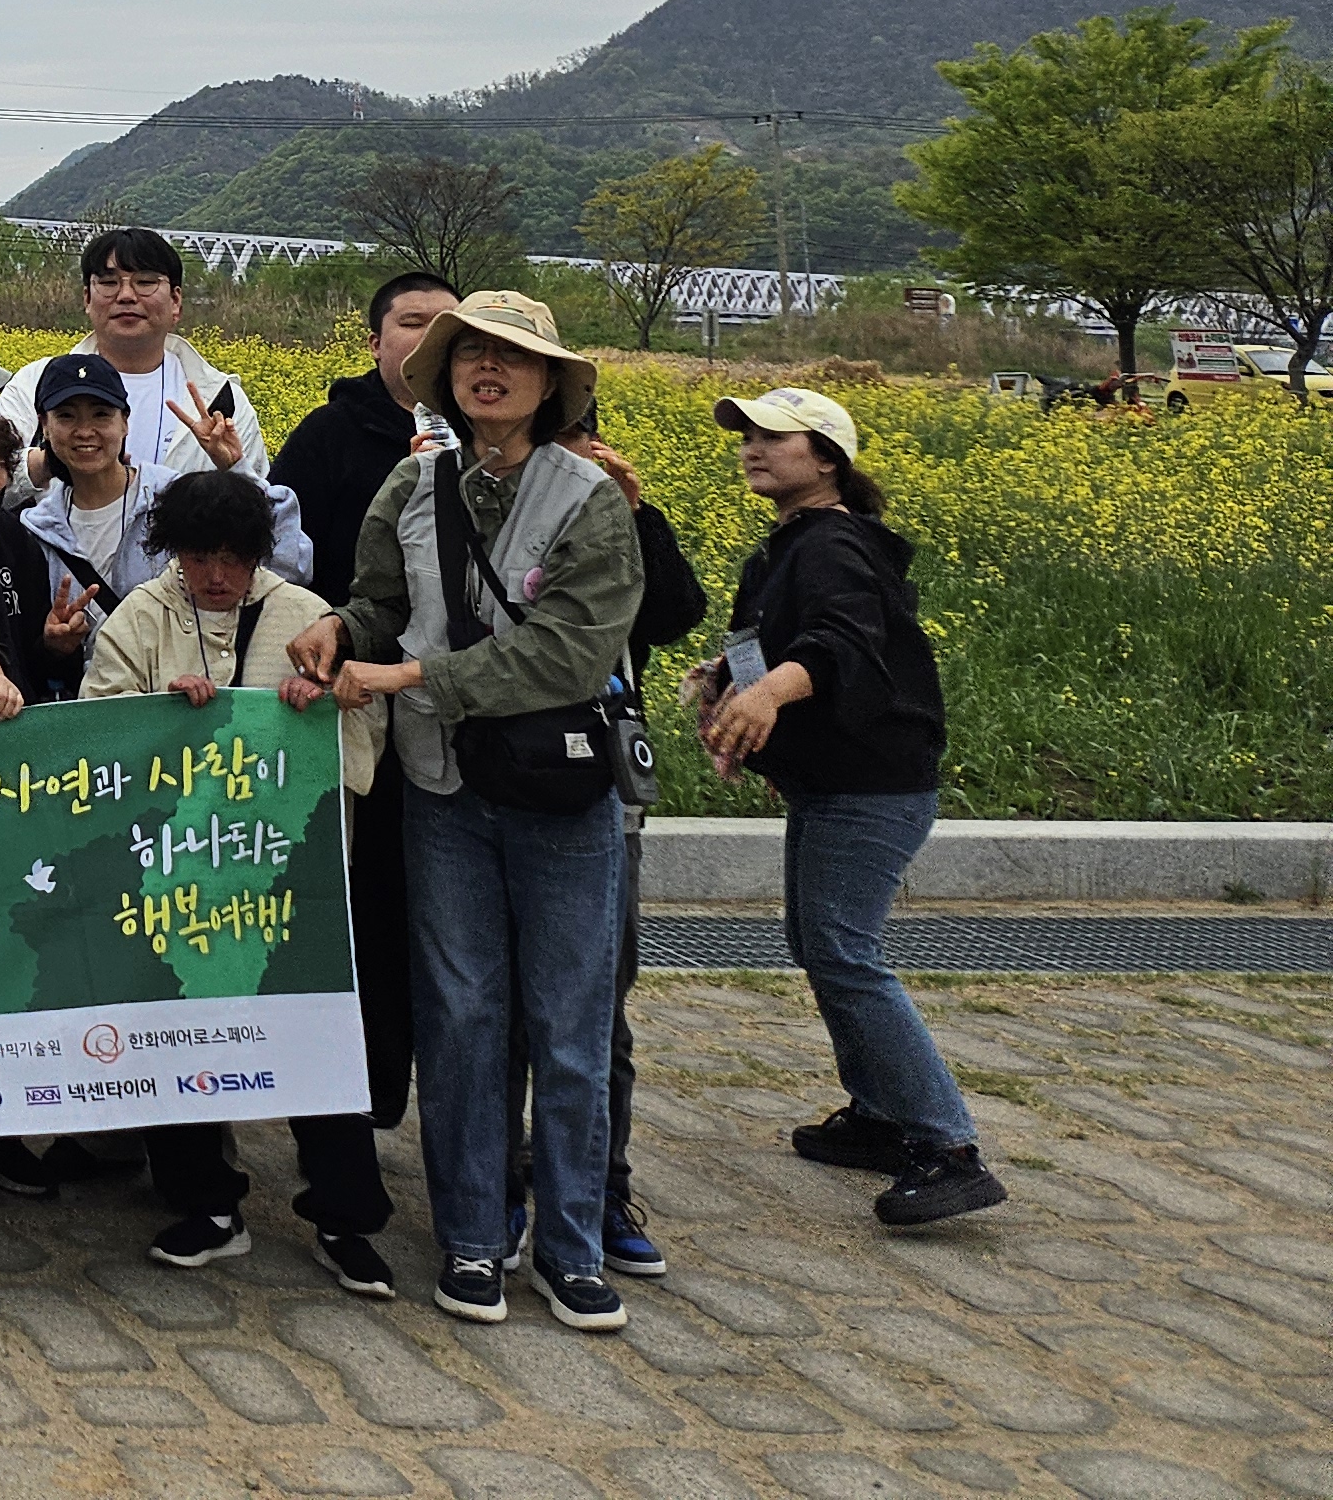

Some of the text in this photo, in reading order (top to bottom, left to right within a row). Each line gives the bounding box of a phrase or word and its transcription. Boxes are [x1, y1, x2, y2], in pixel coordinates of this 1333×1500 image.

[148, 736, 285, 801] 사람이
[129, 813, 292, 876] 하나되는
[113, 883, 293, 954] 행복여행!
[127, 1025, 268, 1050] 한화에어로스페이스
[66, 1077, 158, 1103] 넥센타이어
[176, 1071, 276, 1095] KOSME
